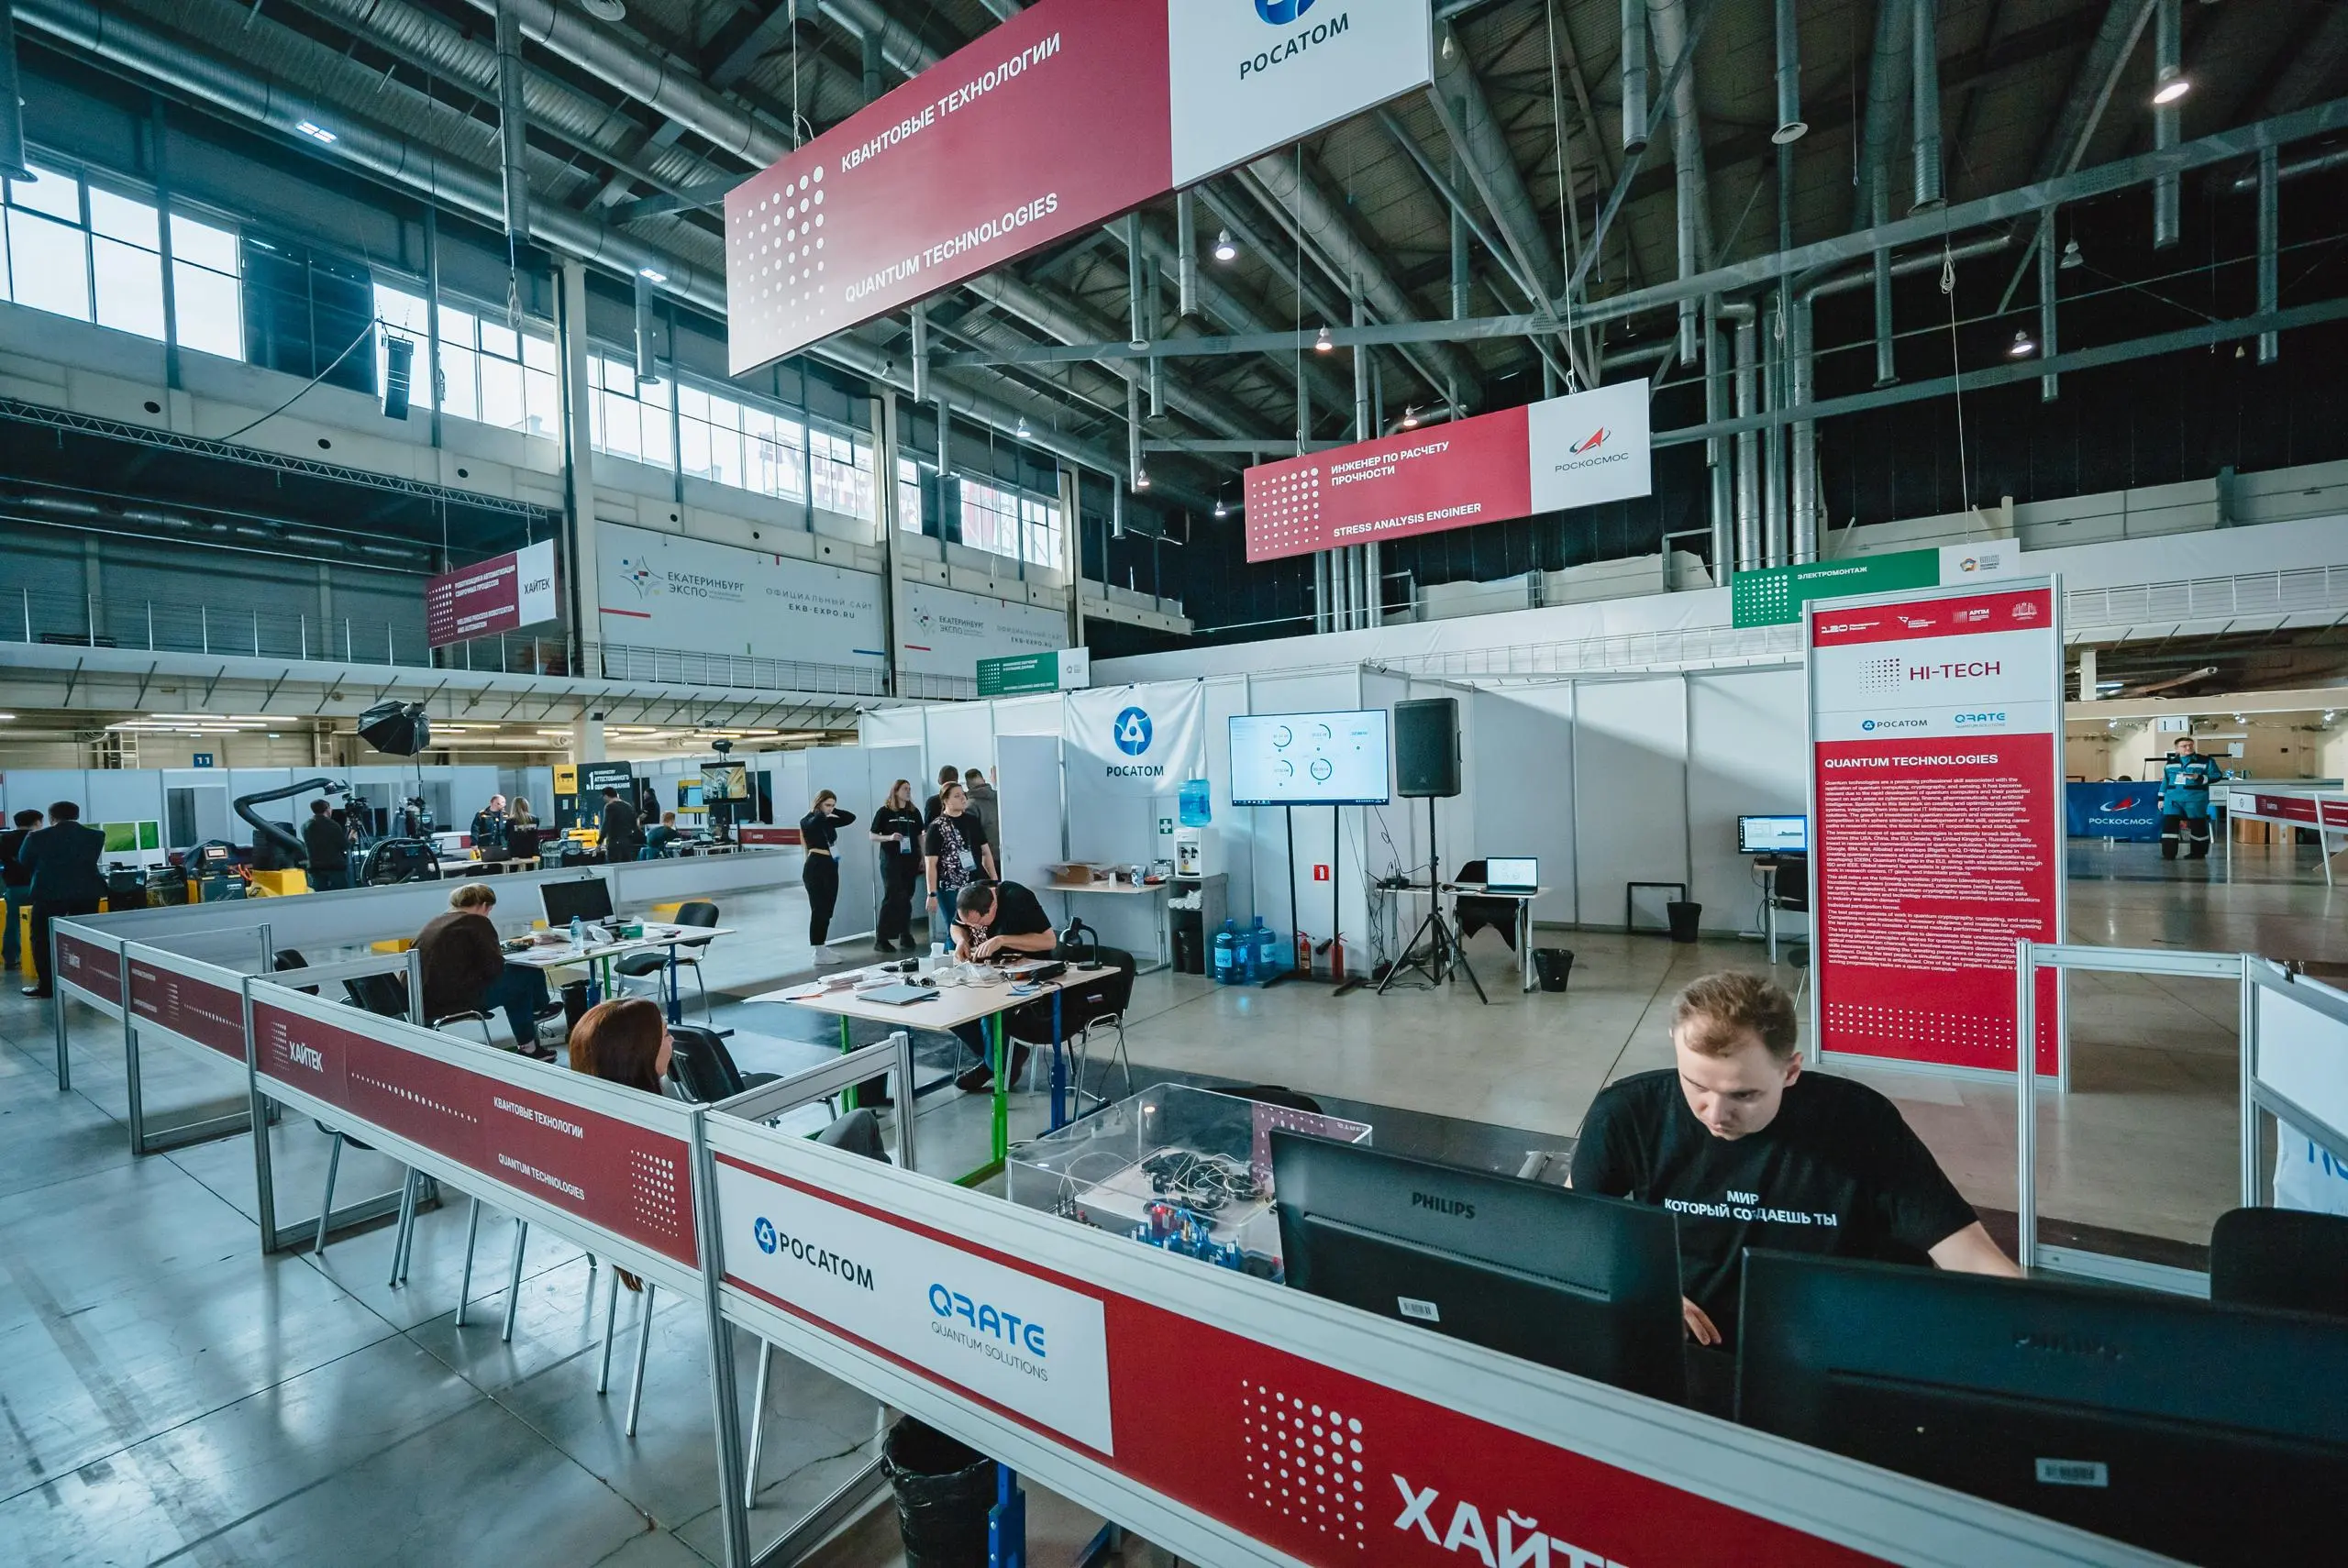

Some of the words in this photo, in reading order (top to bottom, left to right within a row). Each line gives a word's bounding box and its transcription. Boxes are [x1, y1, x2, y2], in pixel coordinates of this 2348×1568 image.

[1239, 12, 1349, 80] РОСАТОМ
[841, 105, 935, 172] КВАНТОВЫЕ
[937, 32, 1060, 116] ТЕХНОЛОГИИ
[845, 255, 919, 302] QUANTUM
[923, 193, 1058, 268] TECHNOLOGIES
[1331, 456, 1381, 474] ИНЖЕНЕР
[1383, 452, 1398, 464] ПО
[1400, 441, 1449, 460] РАСЧЕТУ
[1555, 452, 1629, 472] РОСКОСМОС
[1332, 465, 1395, 486] ПРОЧНОСТИ
[1334, 523, 1372, 537] STRESS
[1374, 513, 1424, 530] ANALYSIS
[1426, 502, 1481, 521] ENGINEER
[668, 571, 745, 592] ЕКАТЕРИНБУРГ
[1797, 566, 1867, 580] ЭЛЕКТРОМОНТАЖ
[524, 578, 550, 595] ХАЙТЕК
[669, 583, 708, 598] ЭКСПО
[765, 587, 845, 606] ОФИЦИАЛЬНЫЙ
[789, 603, 855, 619] EKB-EXPO.RU
[1910, 660, 2001, 680] HI-TECH
[1877, 719, 1928, 728] РОСАТОМ
[1955, 712, 2006, 723] QRATE
[197, 756, 210, 765] 11
[1824, 756, 1889, 768] QUANTUM
[1892, 754, 1999, 767] TECHNOLOGIES
[1106, 766, 1164, 777] РОСАТОМ
[2088, 817, 2154, 825] РОСКОСМОС
[289, 1041, 324, 1073] ХАЙТЕК
[493, 1096, 533, 1121] КВАНТОВЫЕ
[534, 1107, 583, 1139] ТЕХНОЛОГИИ
[498, 1153, 531, 1176] QUANTUM
[531, 1165, 585, 1200] TECHNOLOGIES
[1412, 1192, 1476, 1220] PHILIPS
[1726, 1190, 1759, 1206] МИР
[1664, 1198, 1731, 1218] КОТОРЫЙ
[1813, 1213, 1838, 1226] ТЫ
[780, 1231, 874, 1291] РОСАТОМ
[928, 1283, 1047, 1358] QRATE
[931, 1321, 982, 1353] QUANTUM
[985, 1343, 1048, 1382] SOLUTIONS
[1391, 1473, 1630, 1568] ХАЙ
